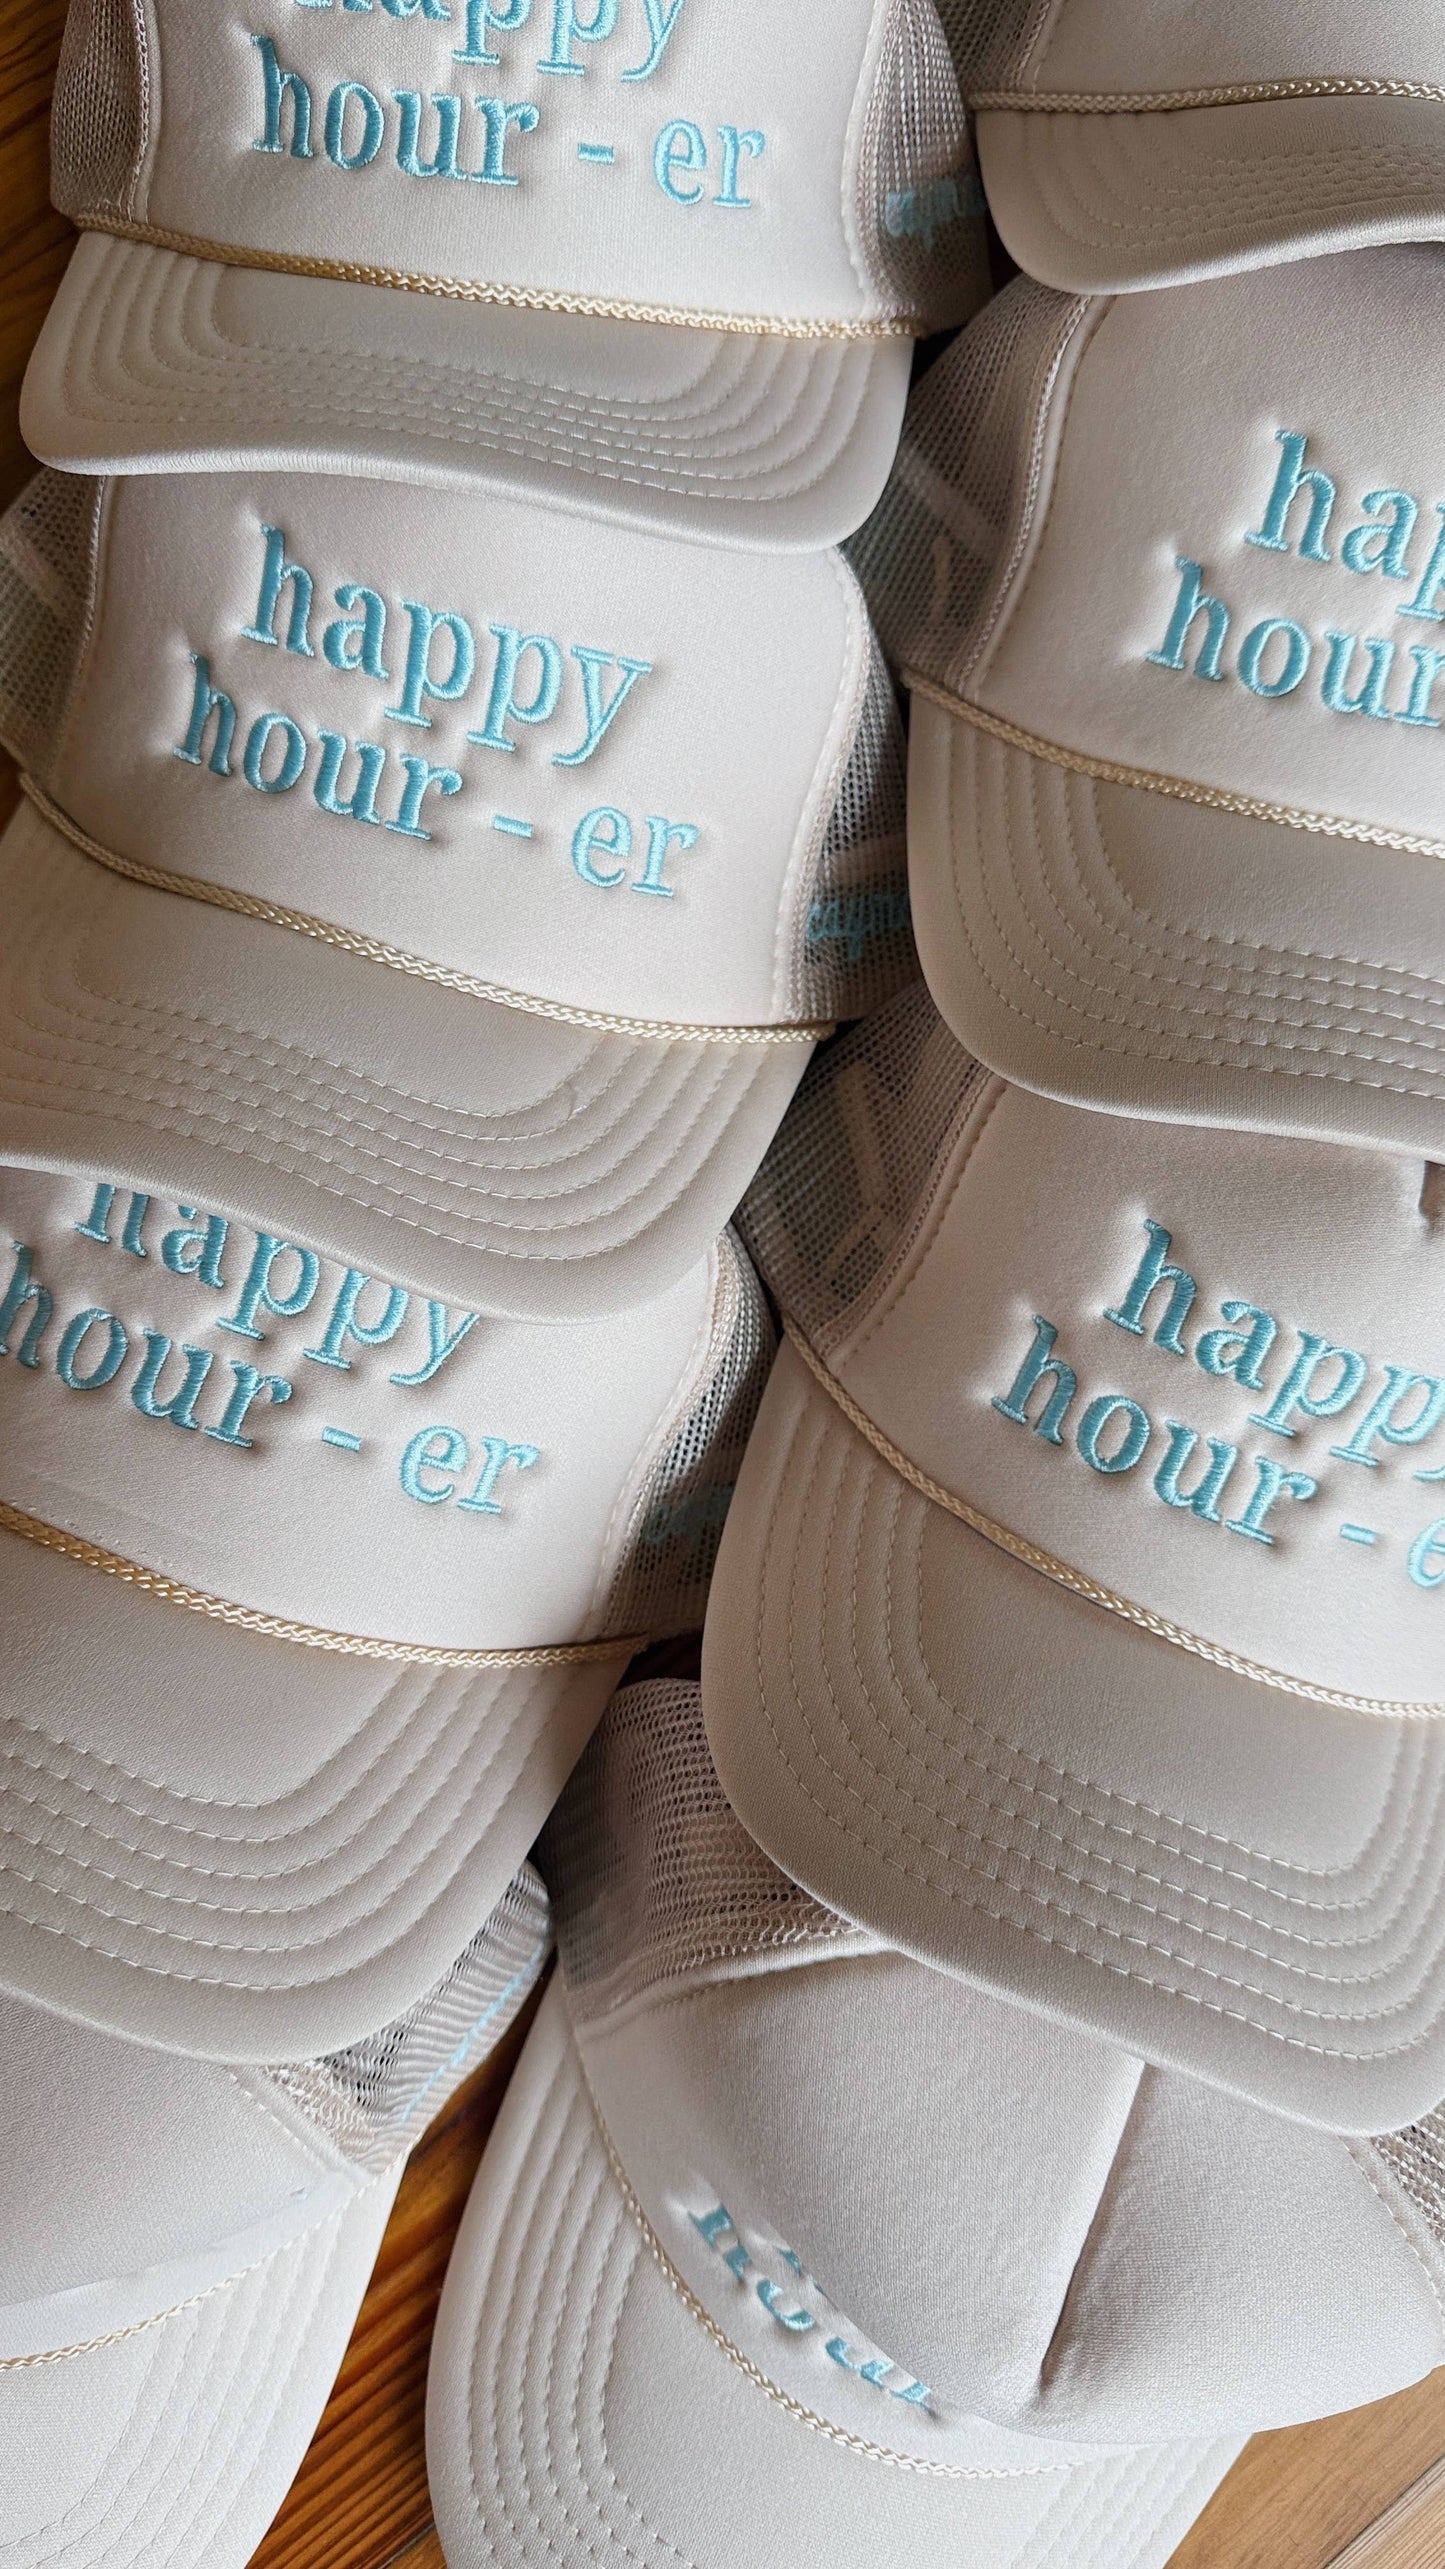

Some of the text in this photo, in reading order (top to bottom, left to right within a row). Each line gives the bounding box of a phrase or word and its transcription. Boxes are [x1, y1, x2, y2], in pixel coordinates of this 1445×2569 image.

[250, 34, 540, 186] hour
[652, 118, 766, 208] er
[293, 0, 686, 83] ppy
[241, 524, 653, 767] happy
[172, 651, 463, 841] hour
[571, 806, 699, 897] er
[0, 1240, 293, 1448] hour
[398, 1424, 540, 1514] er
[991, 1314, 1319, 1546] hour
[1103, 1218, 1445, 1482] happ
